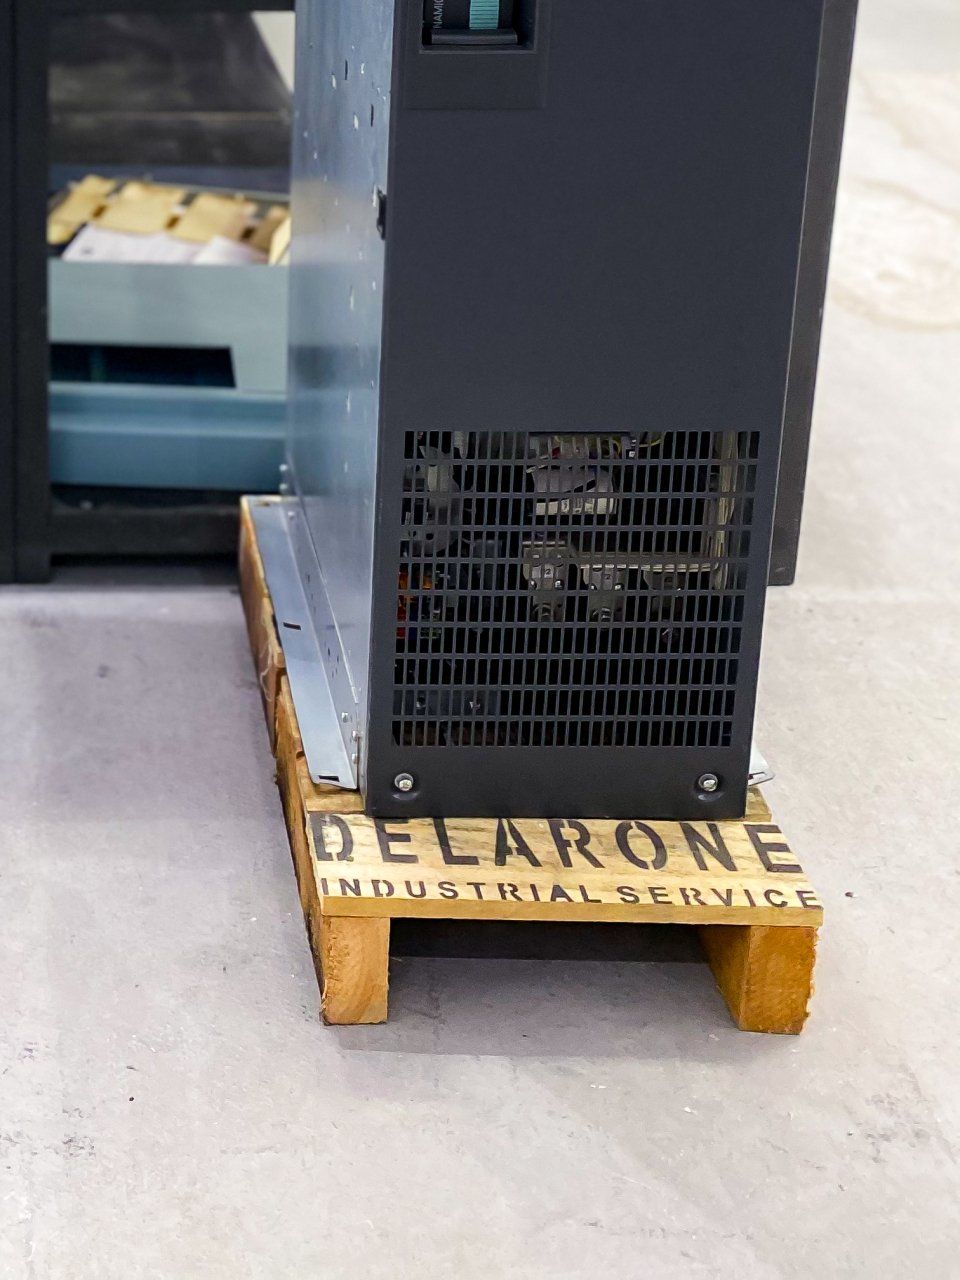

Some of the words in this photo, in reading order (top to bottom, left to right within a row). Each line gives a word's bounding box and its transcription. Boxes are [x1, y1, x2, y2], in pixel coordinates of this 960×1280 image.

[315, 815, 803, 874] DELARONE
[321, 877, 603, 904] INDUSTRIAL
[617, 885, 823, 909] SERVICE
